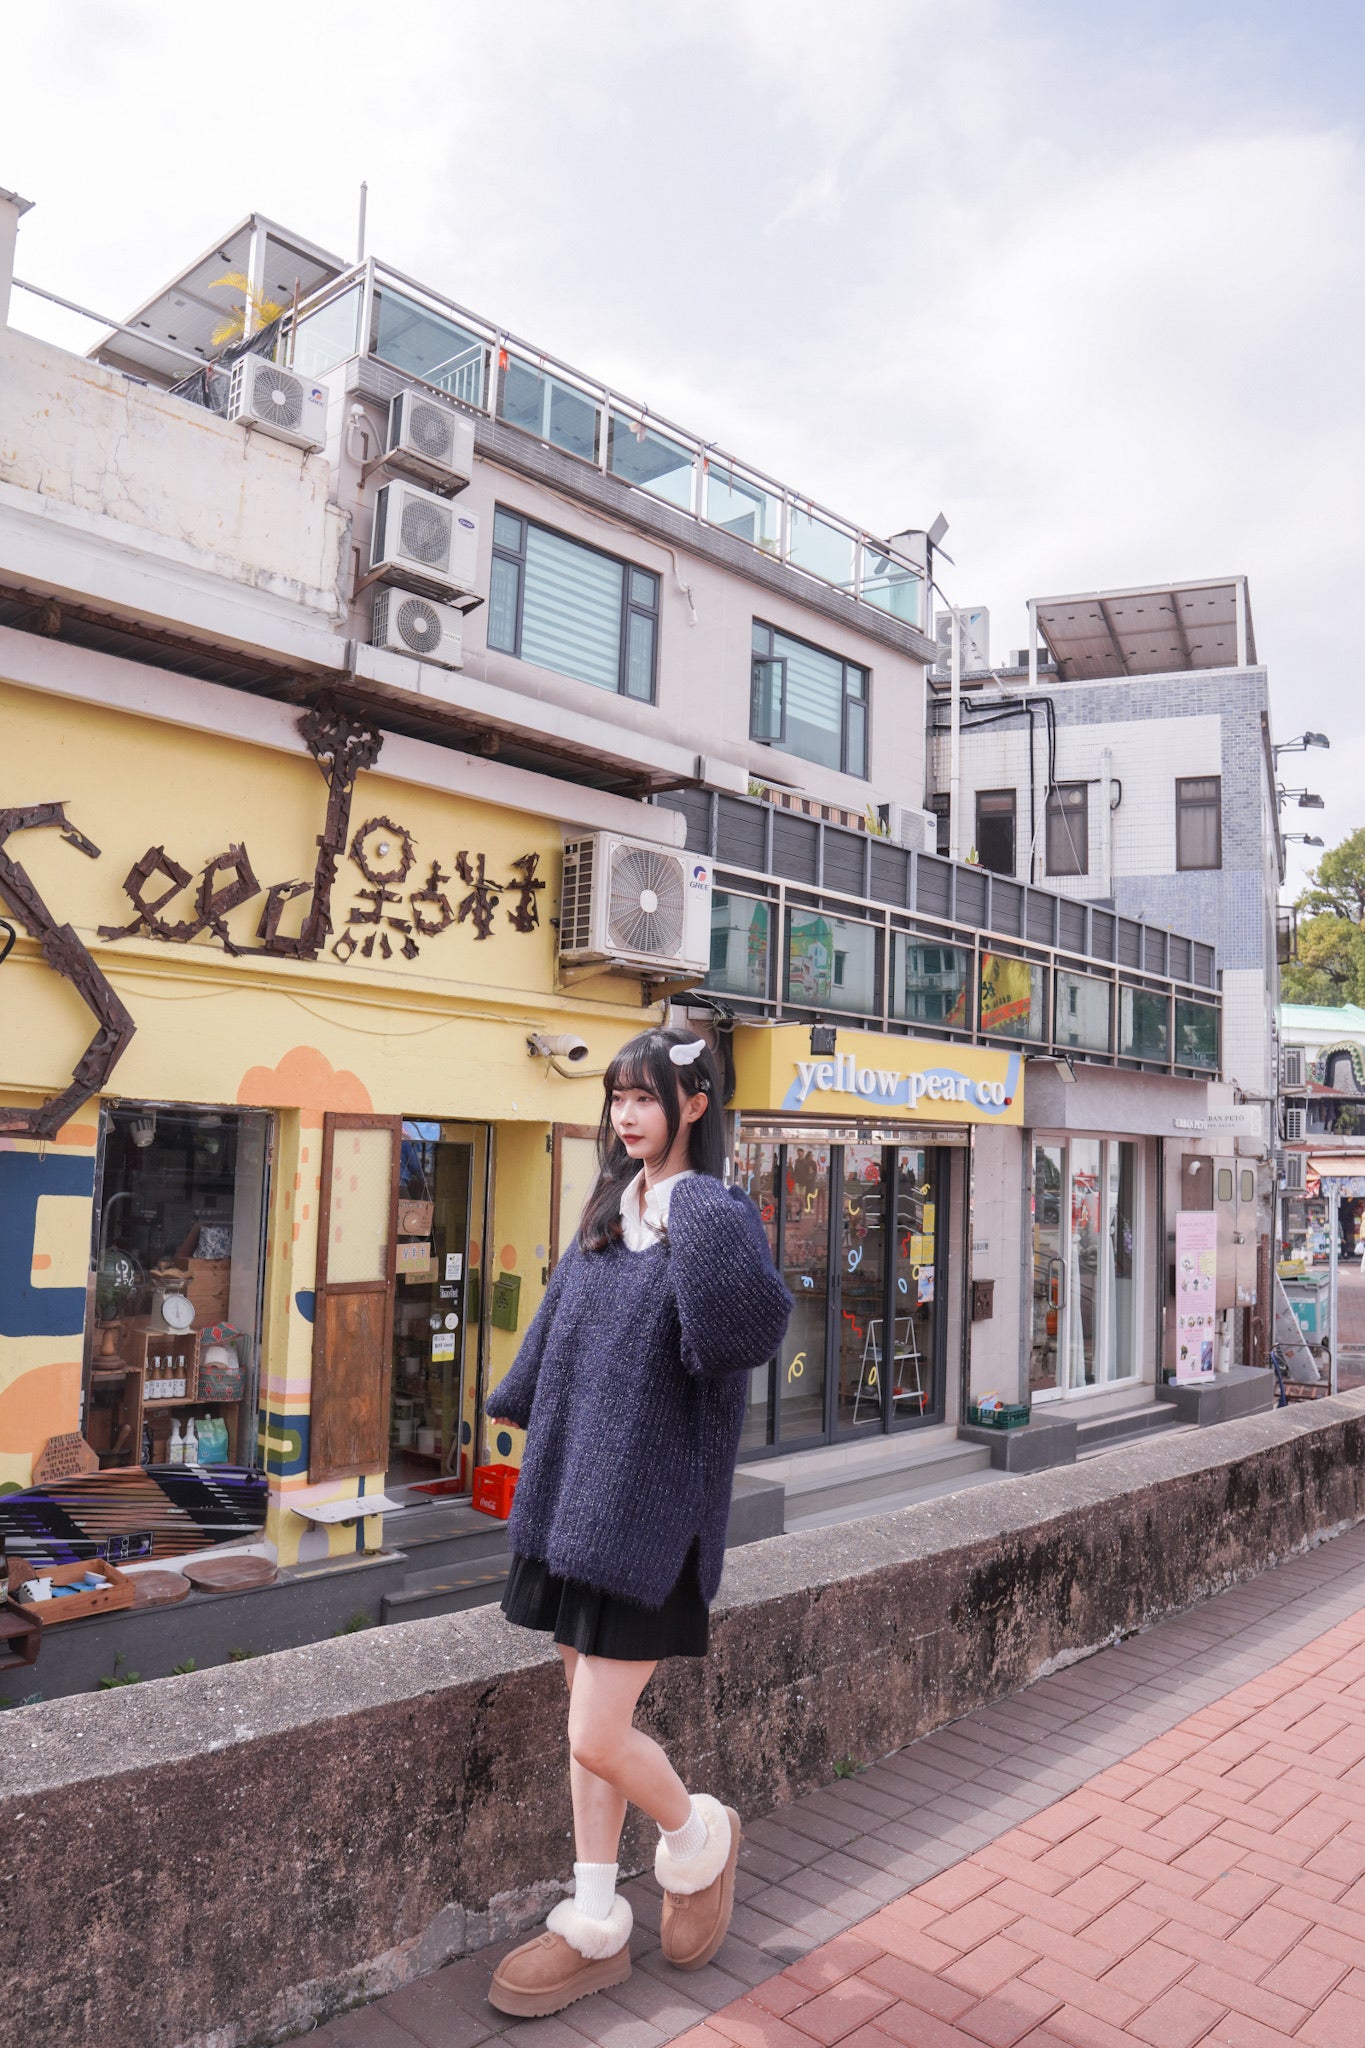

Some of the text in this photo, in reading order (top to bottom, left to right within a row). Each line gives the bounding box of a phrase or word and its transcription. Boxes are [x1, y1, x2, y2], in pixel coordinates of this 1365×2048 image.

[689, 881, 710, 892] GREE
[0, 704, 383, 1140] Seed
[794, 1052, 1013, 1110] yellow pear co.
[1208, 1114, 1223, 1122] BAN
